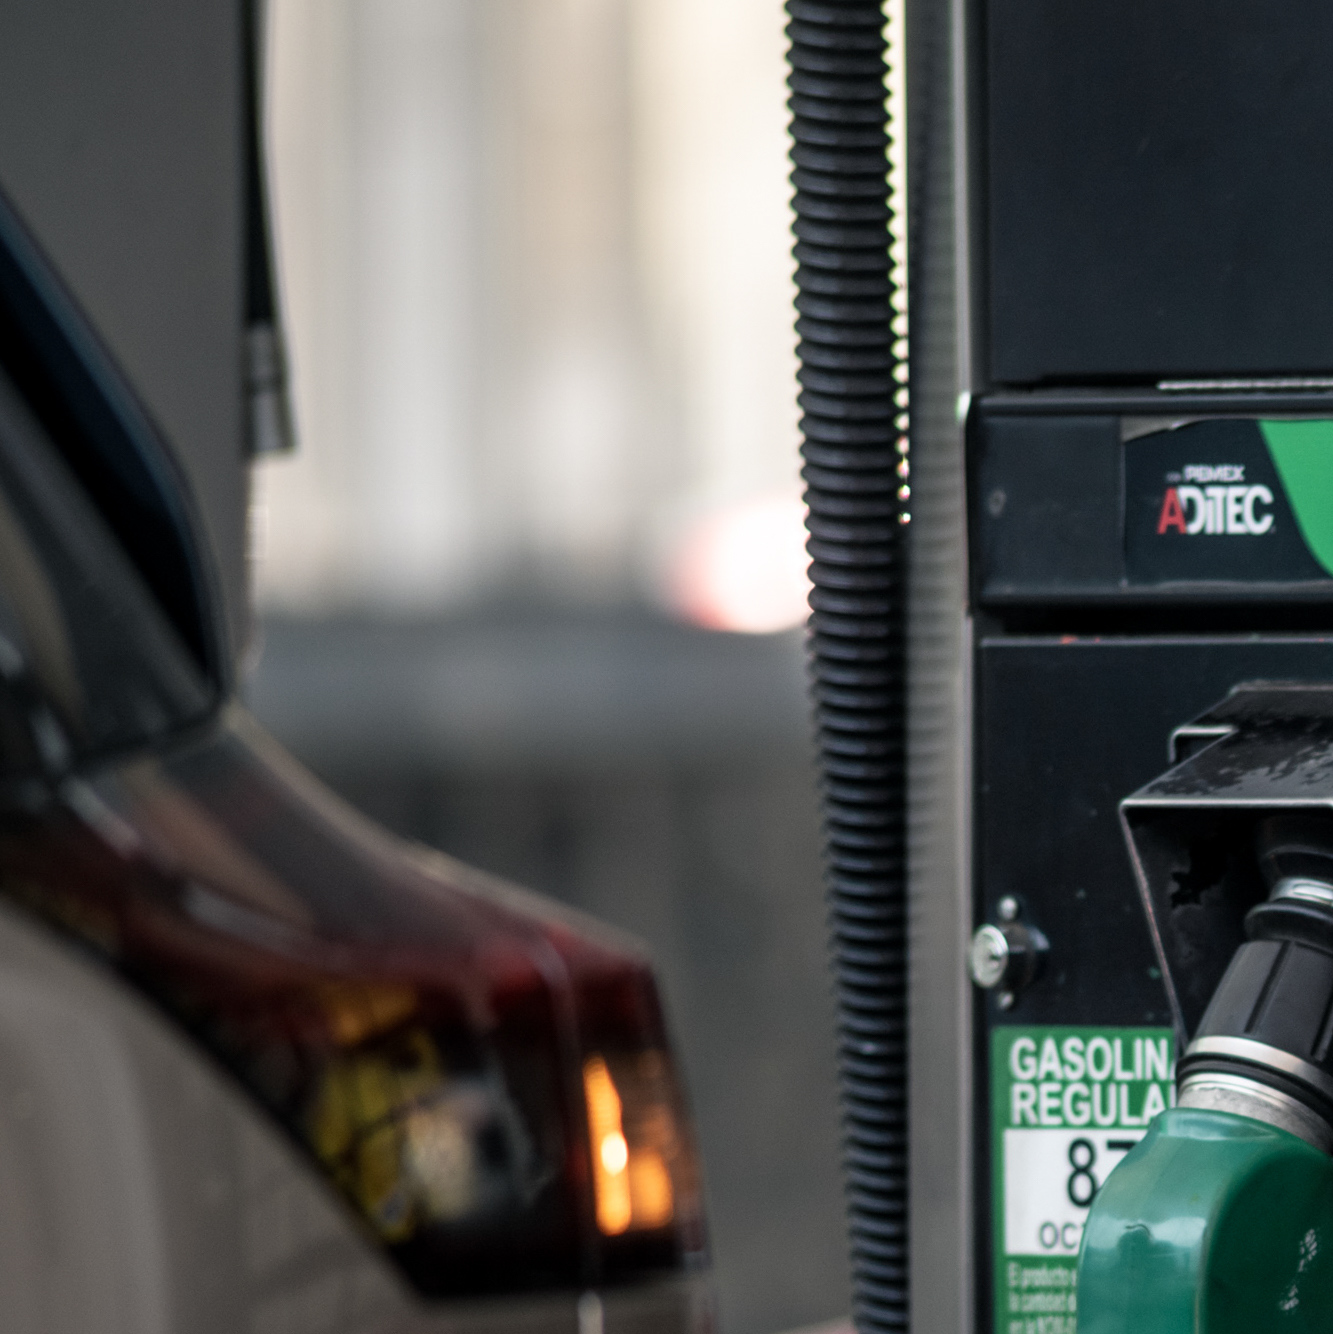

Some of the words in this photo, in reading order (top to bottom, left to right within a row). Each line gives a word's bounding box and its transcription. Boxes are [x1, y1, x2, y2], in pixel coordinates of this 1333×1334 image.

[1184, 464, 1245, 482] PEMEX
[1010, 1037, 1175, 1081] GASOLIN
[1010, 1082, 1177, 1126] REGULA
